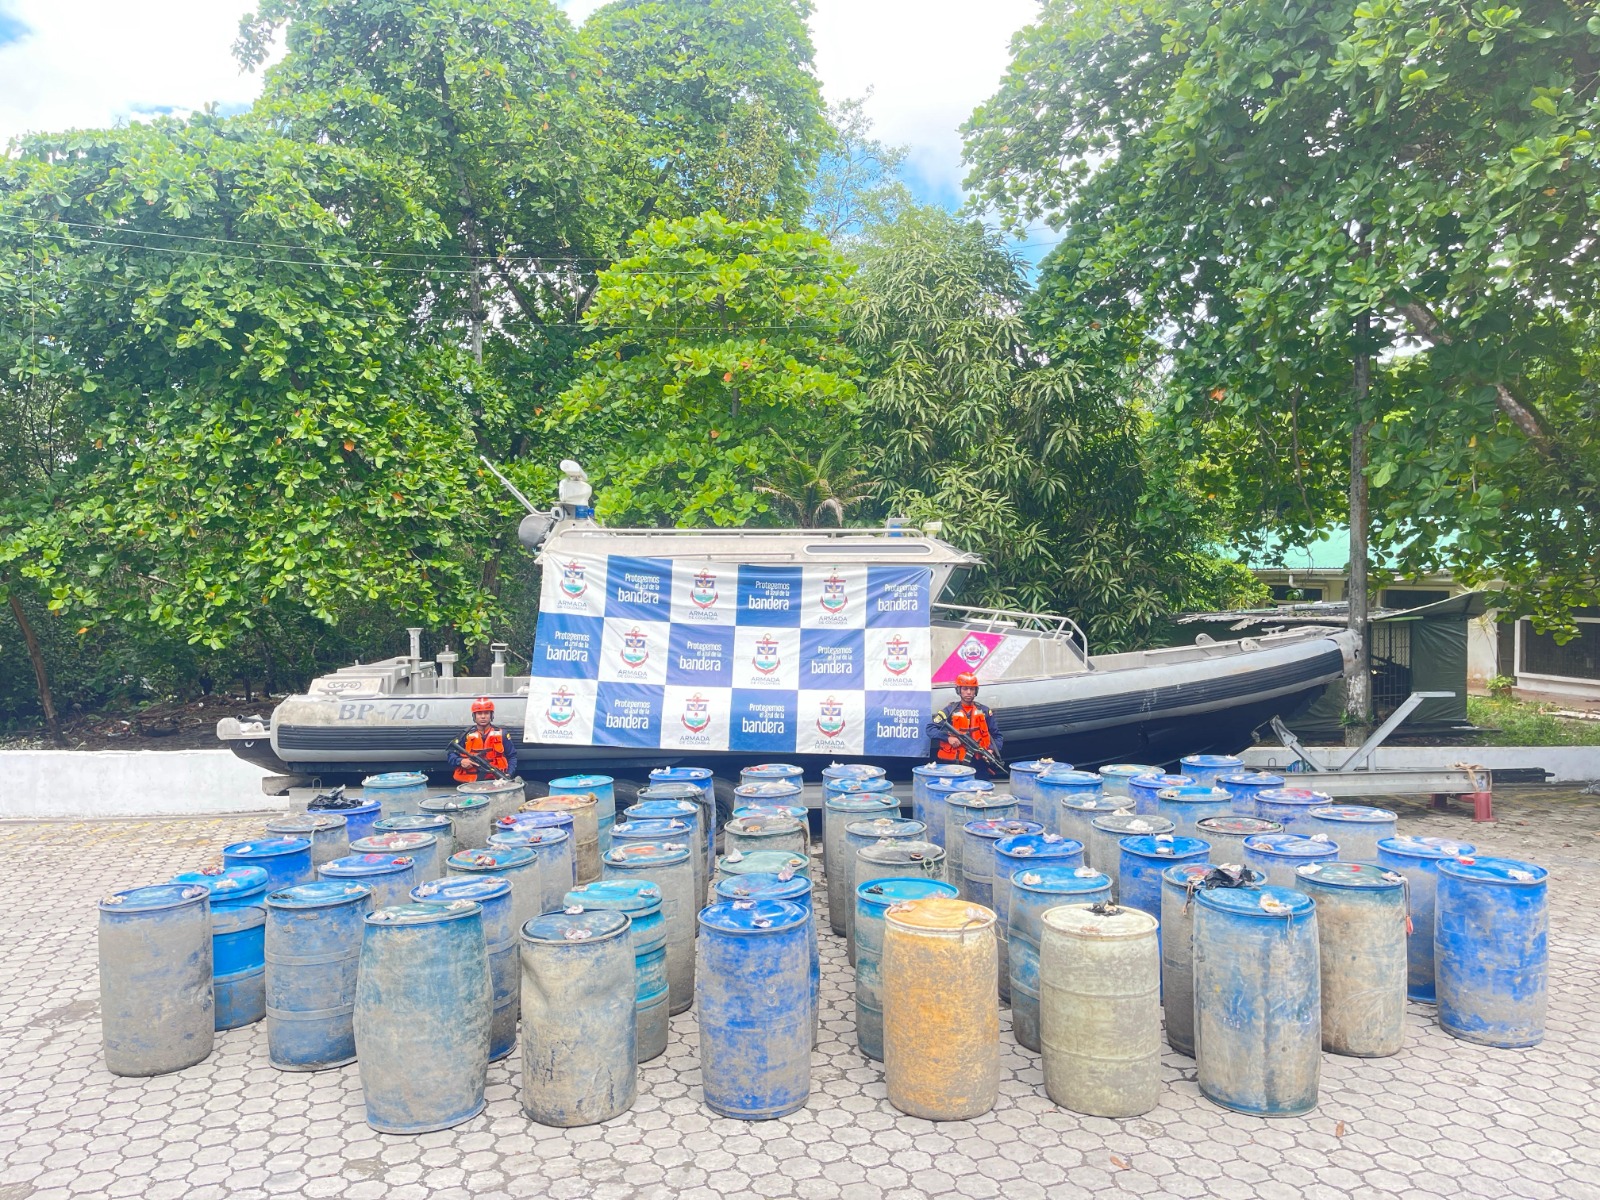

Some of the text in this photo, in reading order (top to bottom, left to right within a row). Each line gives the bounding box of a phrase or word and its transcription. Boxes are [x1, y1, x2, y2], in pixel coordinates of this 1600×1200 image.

[618, 587, 659, 604] bandera
[748, 594, 790, 611] bandera
[878, 598, 918, 612] bandera
[546, 645, 589, 662] bandera
[680, 655, 722, 671] bandera
[811, 660, 853, 674] bandera
[606, 713, 649, 729] bandera
[742, 716, 785, 734] bandera
[876, 722, 919, 739] bandera
